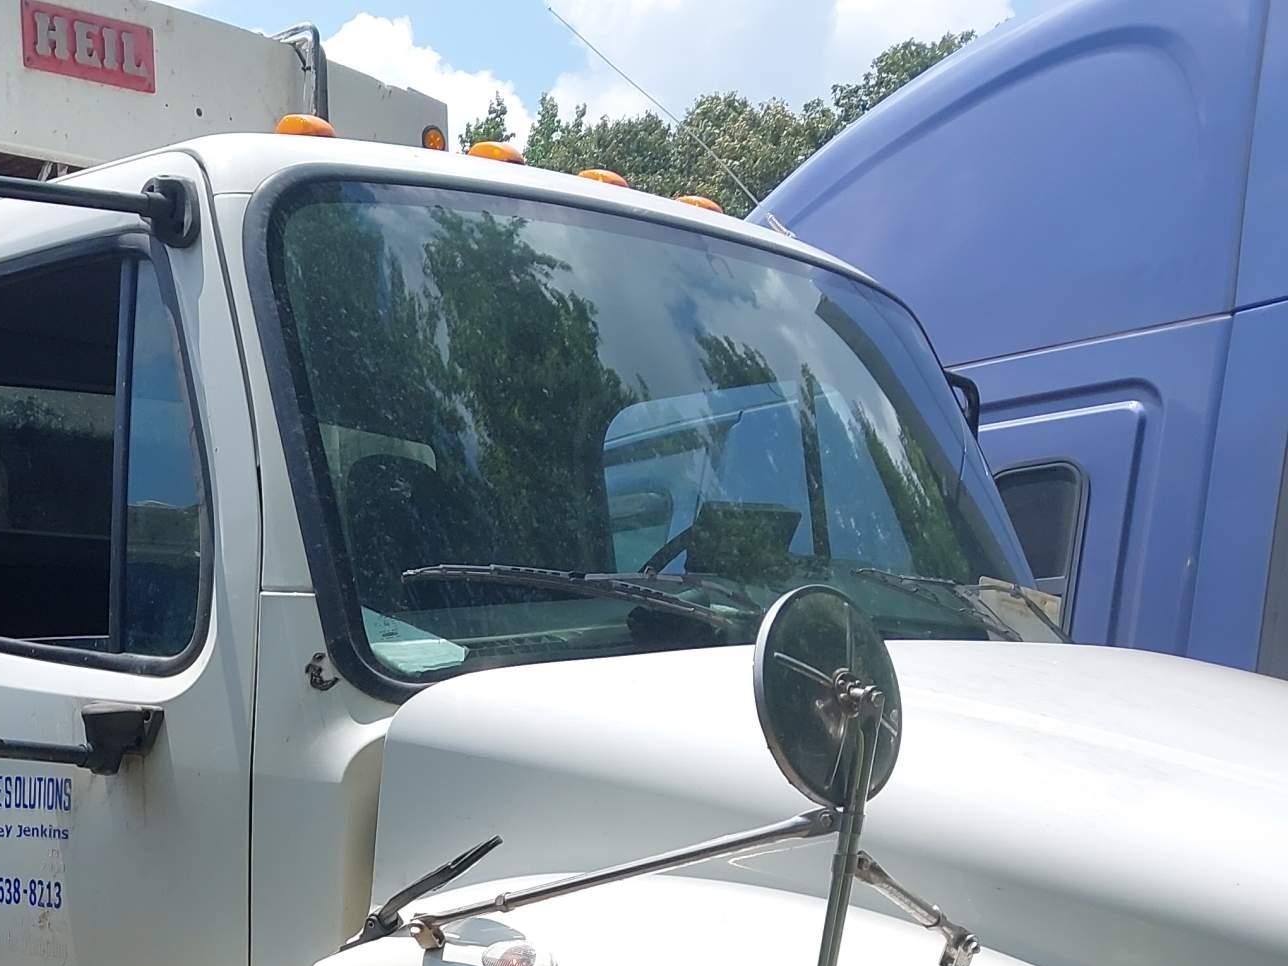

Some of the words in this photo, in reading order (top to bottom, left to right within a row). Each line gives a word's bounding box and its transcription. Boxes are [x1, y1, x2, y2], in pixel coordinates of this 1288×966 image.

[34, 12, 148, 77] HEIL
[4, 776, 72, 811] SOLUTIONS
[16, 824, 69, 840] Jenkins
